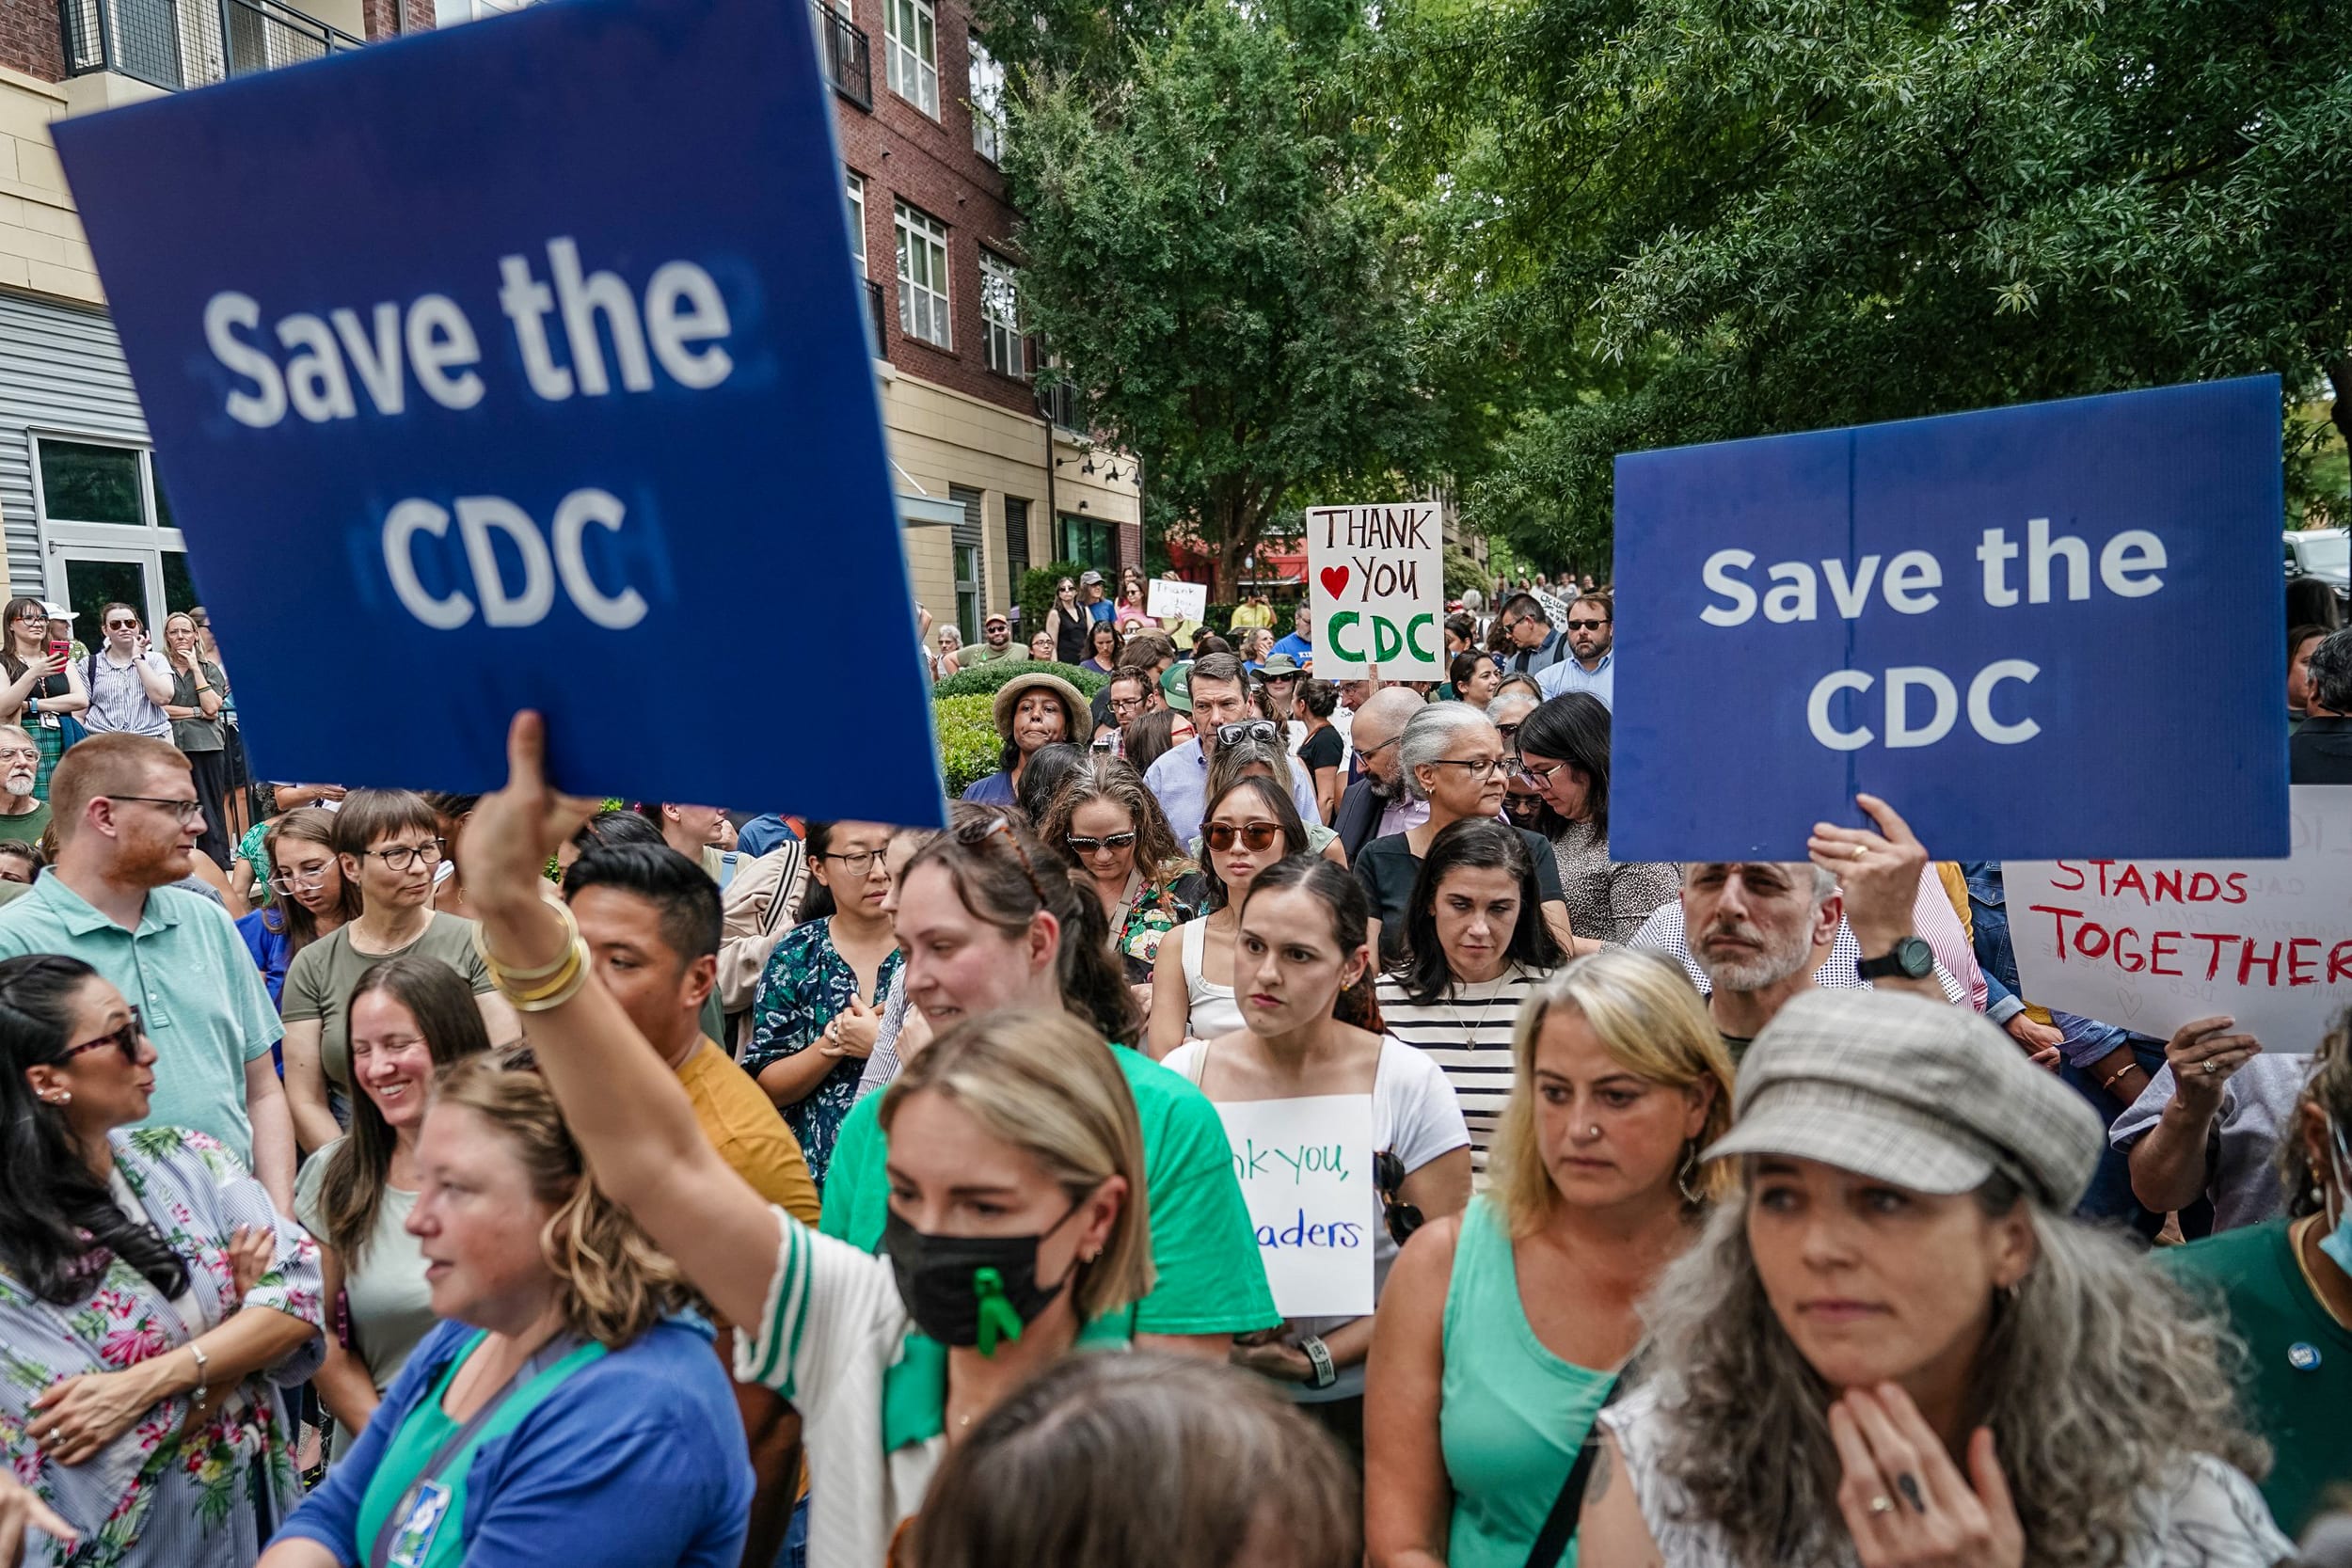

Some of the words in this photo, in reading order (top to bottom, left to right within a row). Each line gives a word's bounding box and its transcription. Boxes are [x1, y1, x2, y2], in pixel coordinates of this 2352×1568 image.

[203, 291, 485, 429] Save
[499, 235, 734, 402] the
[382, 487, 649, 630] CDC
[1312, 508, 1434, 549] THANK
[1352, 556, 1419, 602] YOU
[1699, 548, 1943, 627] Save
[1976, 517, 2168, 609] the
[1327, 610, 1436, 663] CDC
[1807, 659, 2042, 751] CDC
[2049, 859, 2249, 906] STANDS
[2028, 904, 2352, 988] TOGETHER
[1274, 1145, 1349, 1185] you,
